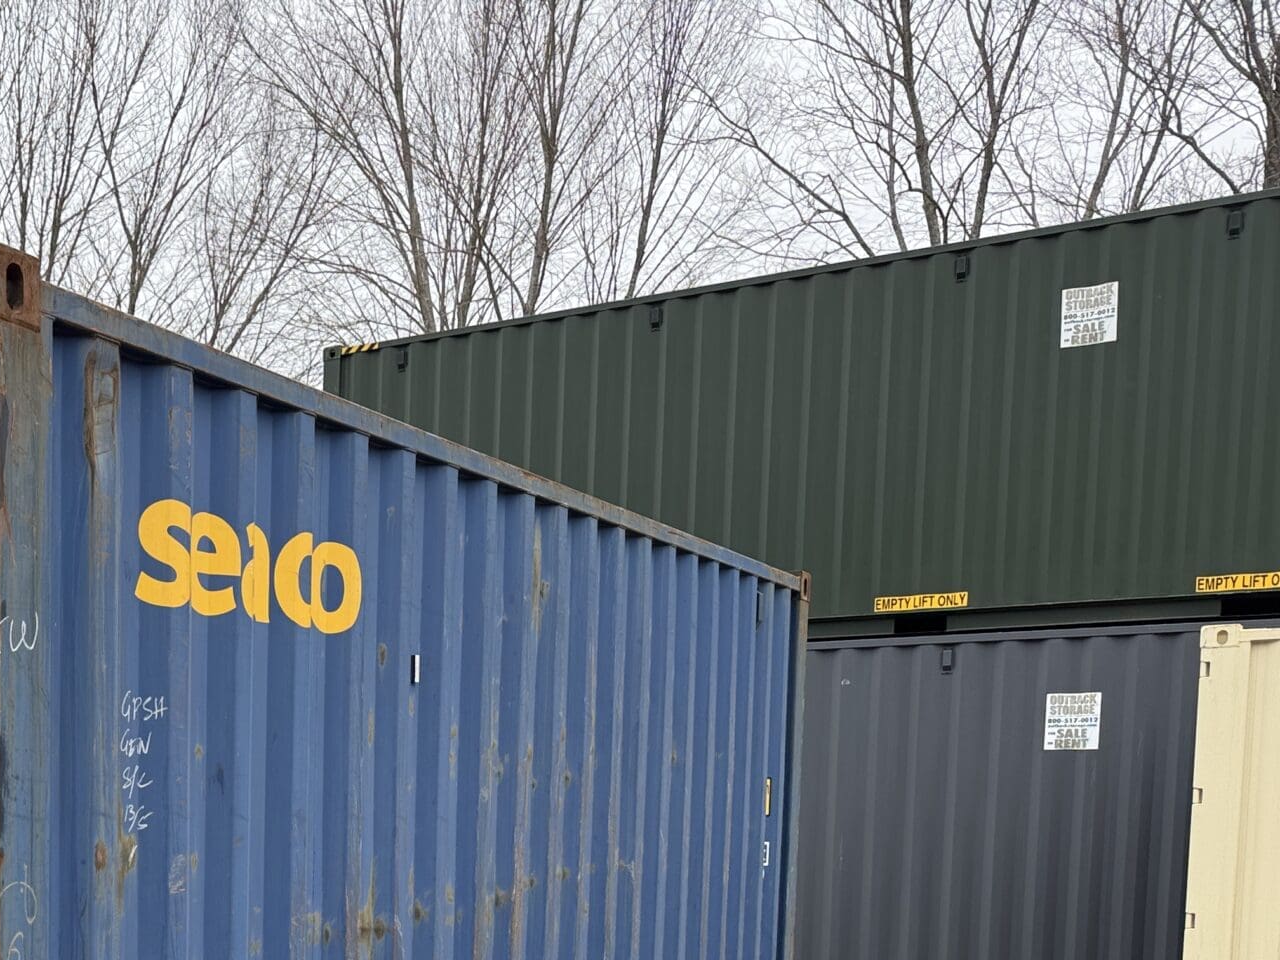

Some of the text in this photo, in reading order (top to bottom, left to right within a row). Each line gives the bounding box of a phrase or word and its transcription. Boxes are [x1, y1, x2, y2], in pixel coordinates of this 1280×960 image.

[1065, 283, 1114, 301] OUTBACK
[1065, 295, 1112, 311] STORAGE
[1064, 307, 1116, 320] 800-517-0012
[1073, 320, 1105, 335] SALE
[1071, 331, 1107, 345] RENT
[134, 499, 362, 634] seaco
[1198, 575, 1238, 591] EMPTY
[1242, 574, 1268, 588] LIFT
[876, 593, 966, 611] EMPTY LIFT ONLY
[1050, 694, 1097, 705] OUTBACK
[1050, 704, 1095, 715] STORAGE
[1056, 728, 1088, 738] SALE
[1054, 738, 1089, 748] RENT
